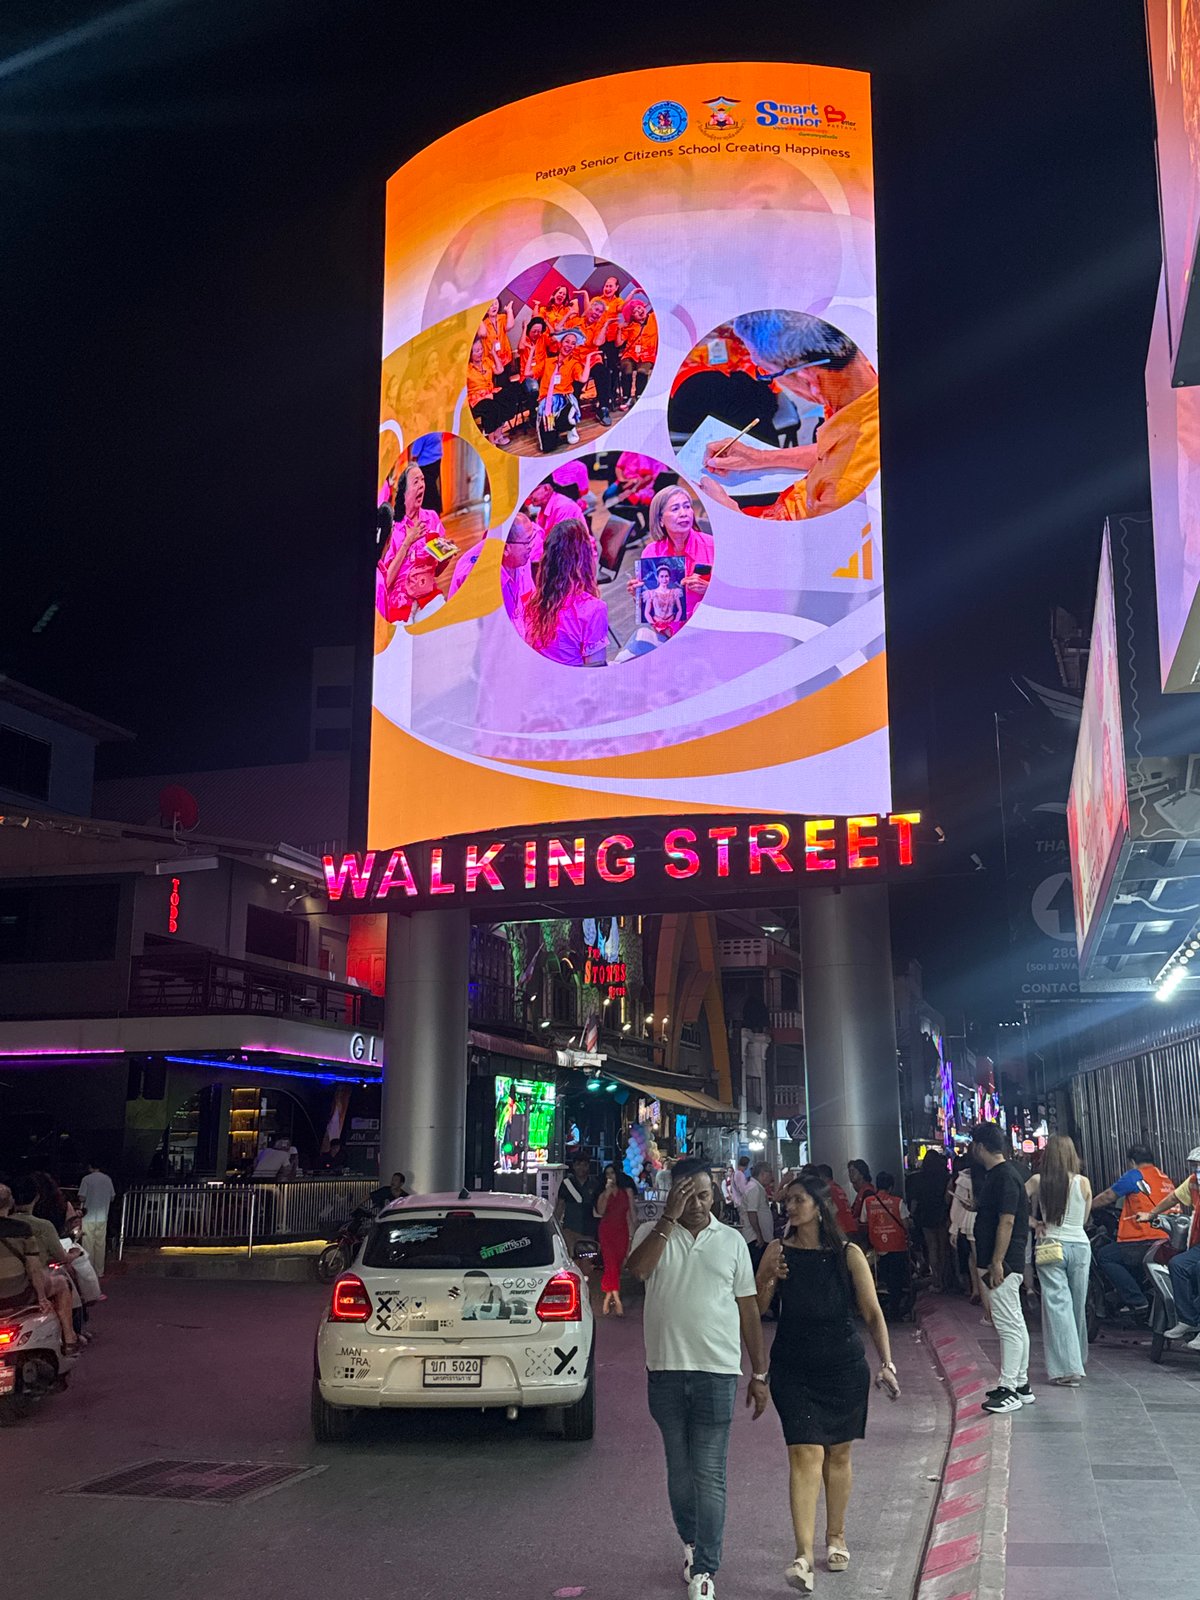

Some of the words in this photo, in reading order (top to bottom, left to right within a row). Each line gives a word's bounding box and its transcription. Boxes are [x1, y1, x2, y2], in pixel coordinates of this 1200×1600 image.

[755, 100, 819, 119] Smart
[535, 164, 576, 181] Pattaya
[580, 155, 619, 170] Senior
[623, 148, 673, 162] Citizens
[678, 143, 721, 155] School
[725, 142, 780, 155] Creating
[785, 143, 850, 158] Happiness
[322, 834, 636, 900] WALKING
[664, 812, 921, 879] STREET
[1021, 982, 1079, 994] CONTAC
[452, 1360, 478, 1372] 5020
